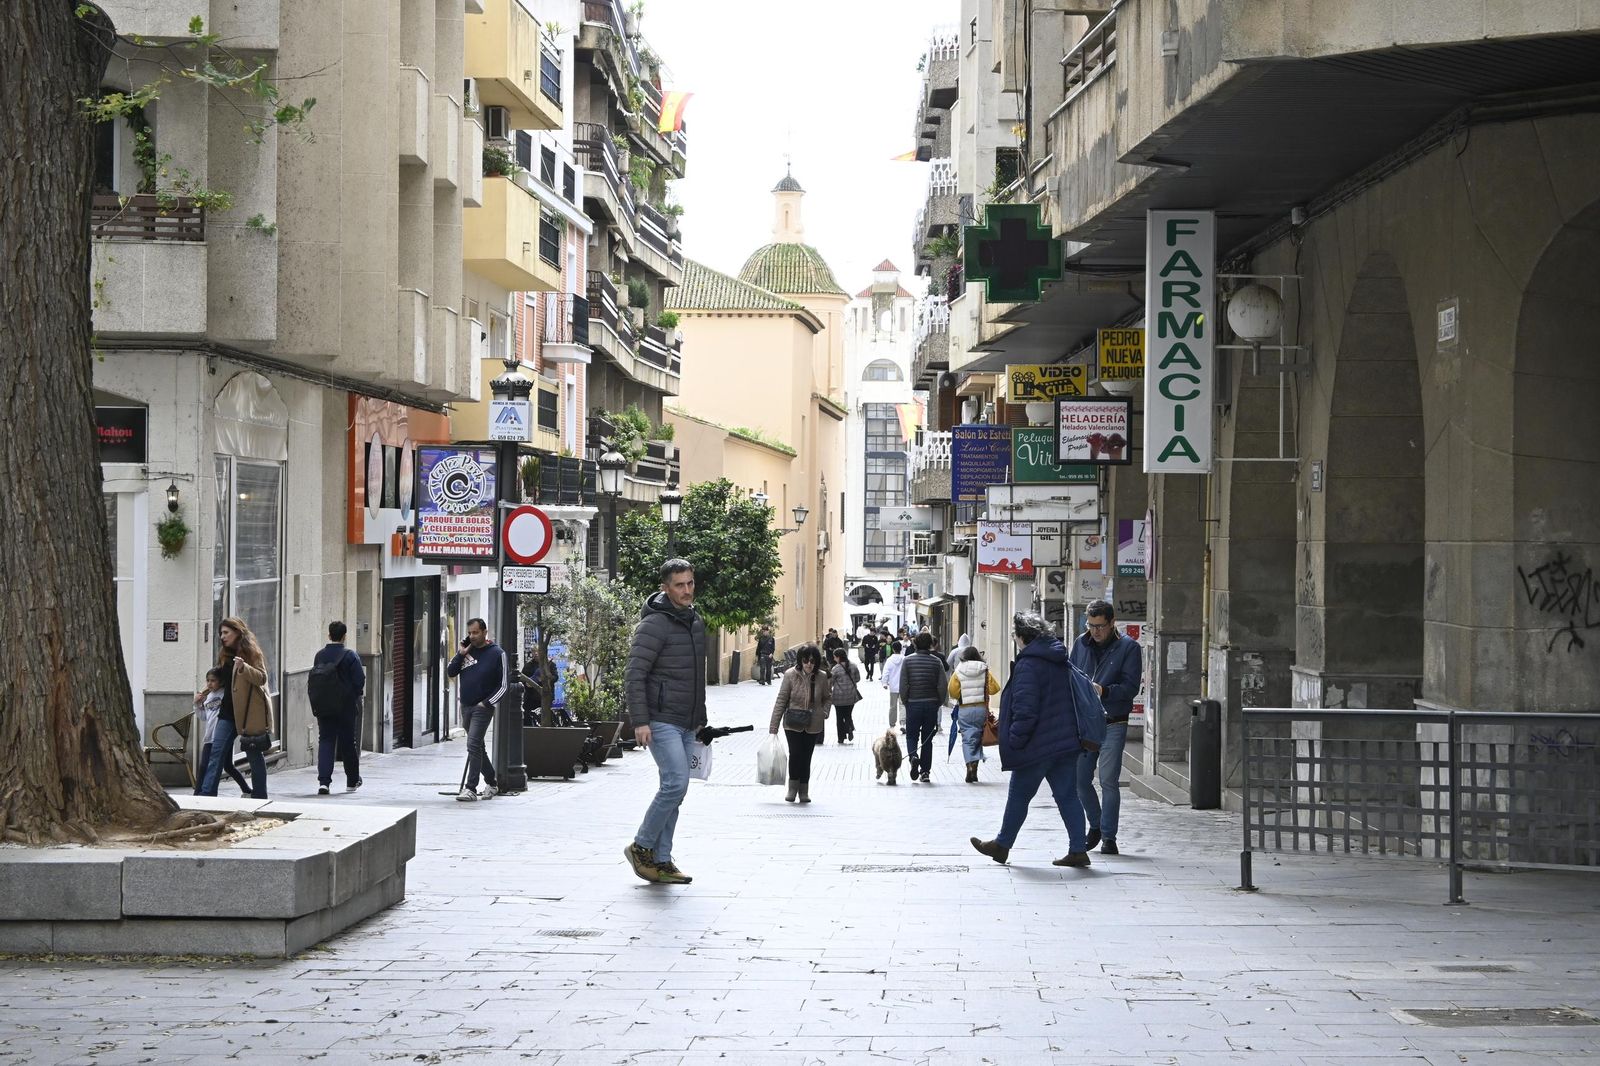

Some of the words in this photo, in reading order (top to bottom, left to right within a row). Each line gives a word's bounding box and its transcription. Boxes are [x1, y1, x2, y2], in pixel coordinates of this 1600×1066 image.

[1102, 331, 1140, 346] PEDRO
[1157, 219, 1204, 464] FARMACIA
[1062, 413, 1126, 423] HELADERÍA
[1018, 432, 1053, 444] Peluqu
[462, 456, 484, 480] Park
[434, 493, 477, 512] Marina
[419, 546, 442, 554] CALLE
